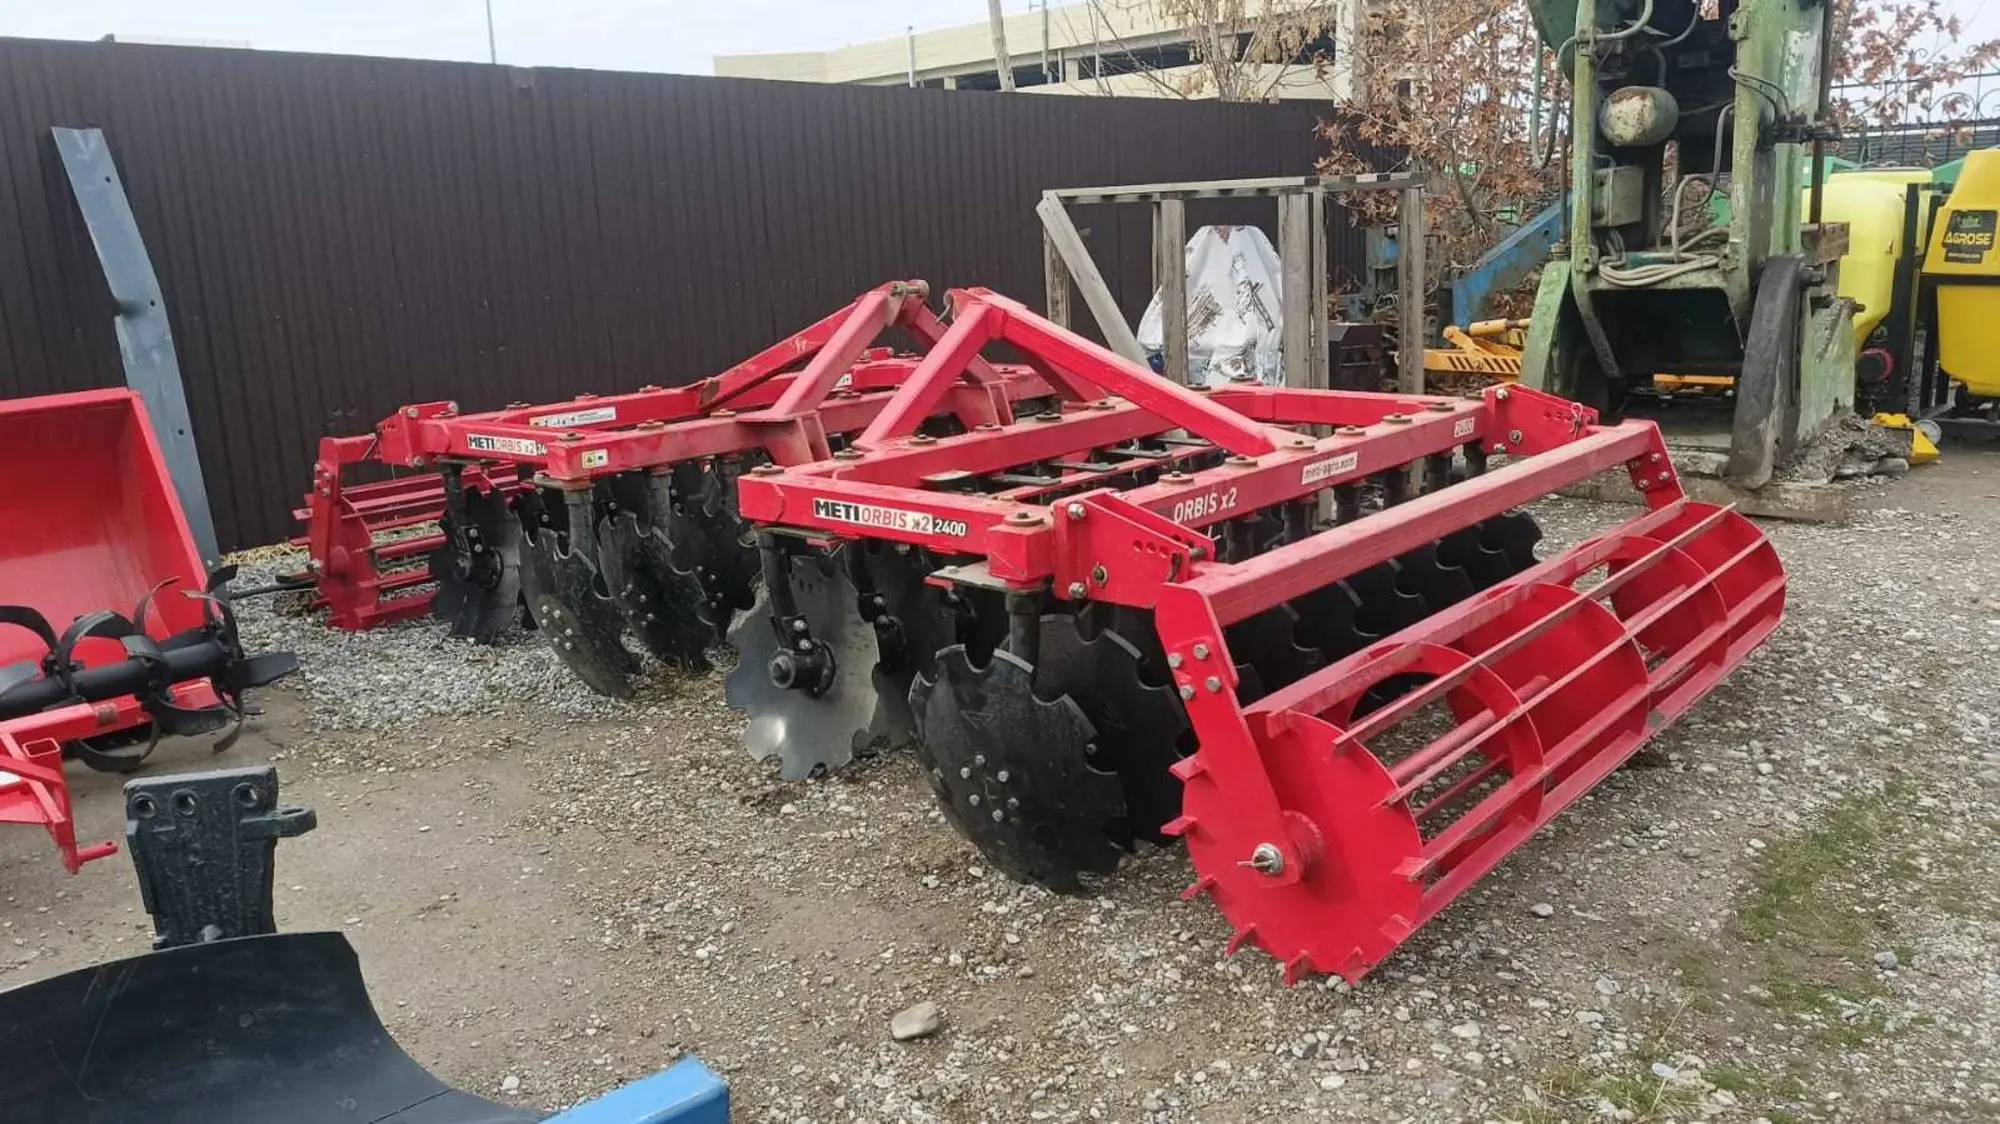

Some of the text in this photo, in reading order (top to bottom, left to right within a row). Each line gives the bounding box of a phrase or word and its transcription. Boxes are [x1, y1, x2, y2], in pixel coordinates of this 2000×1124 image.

[1944, 232, 1992, 245] AGROSE
[495, 438, 522, 453] ORBIS
[814, 499, 860, 522] METI
[861, 508, 908, 528] ORBIS
[934, 519, 967, 536] 2400
[1174, 487, 1237, 524] ORBIS x2
